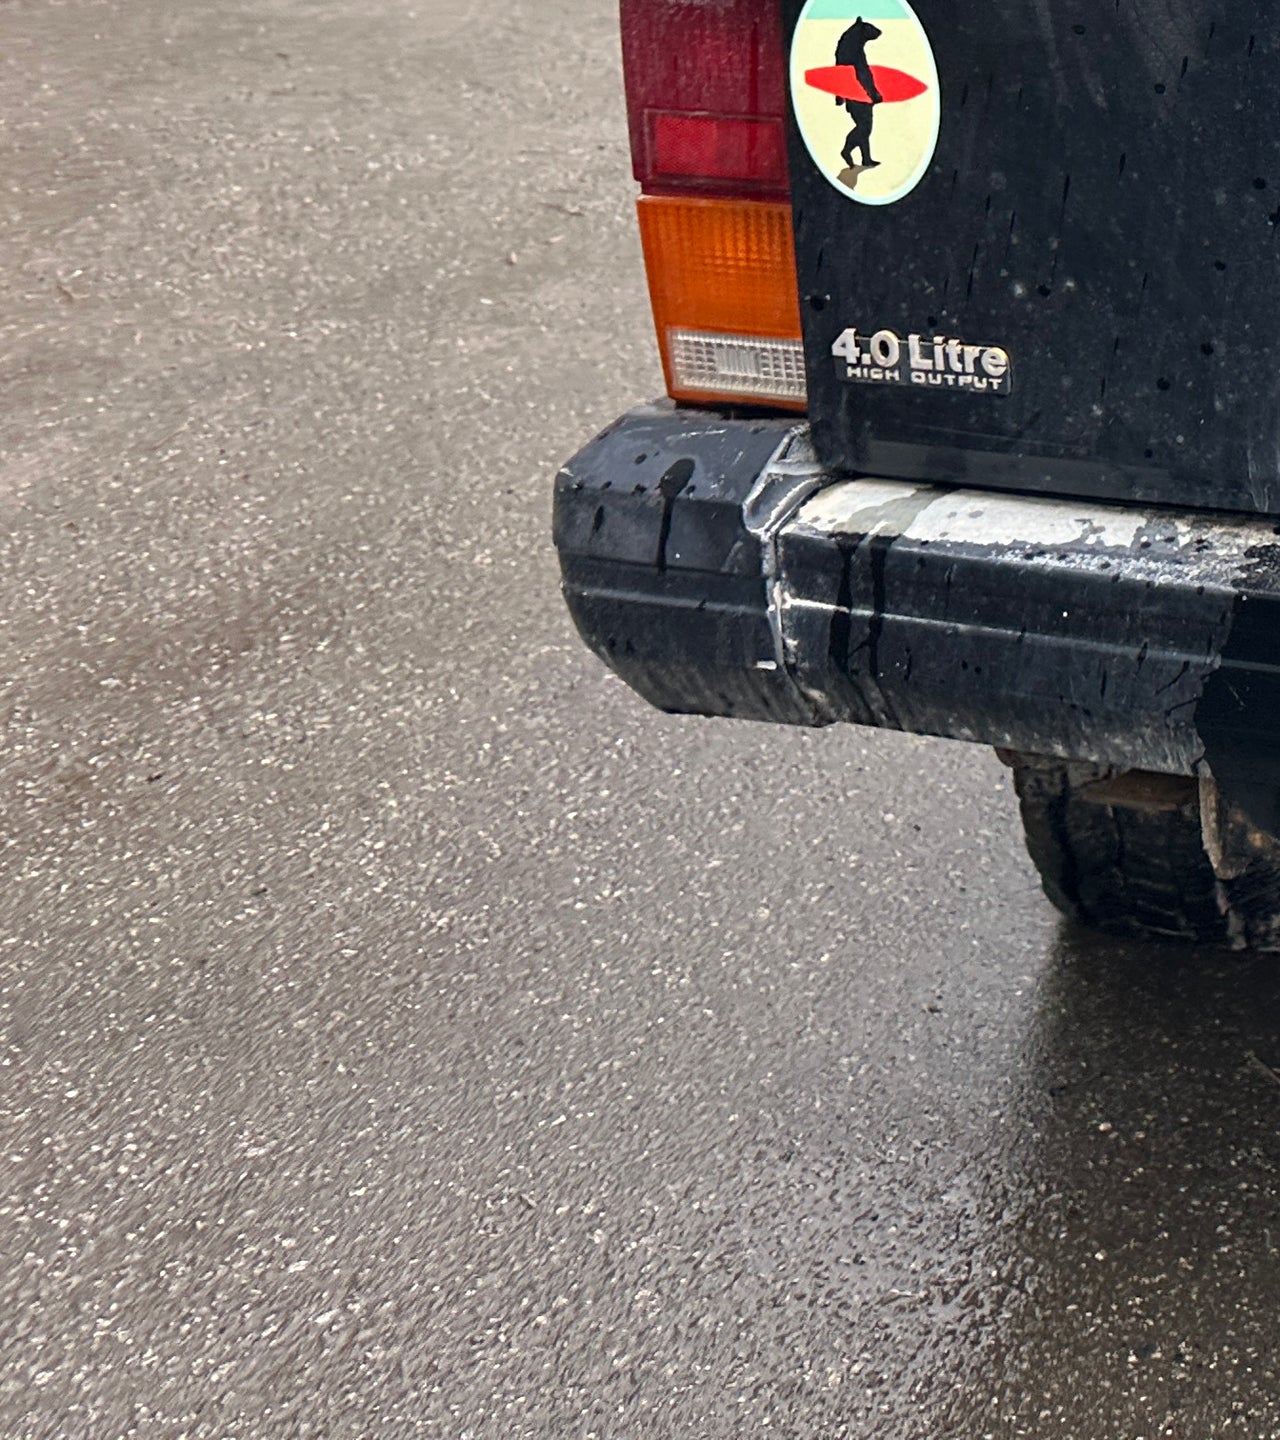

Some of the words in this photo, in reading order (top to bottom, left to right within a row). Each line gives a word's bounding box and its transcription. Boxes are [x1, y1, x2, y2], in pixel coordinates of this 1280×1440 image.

[831, 327, 900, 368] 4.0
[908, 333, 1009, 377] Litre
[846, 366, 900, 381] HIGH
[911, 371, 1003, 391] OUTPUT
